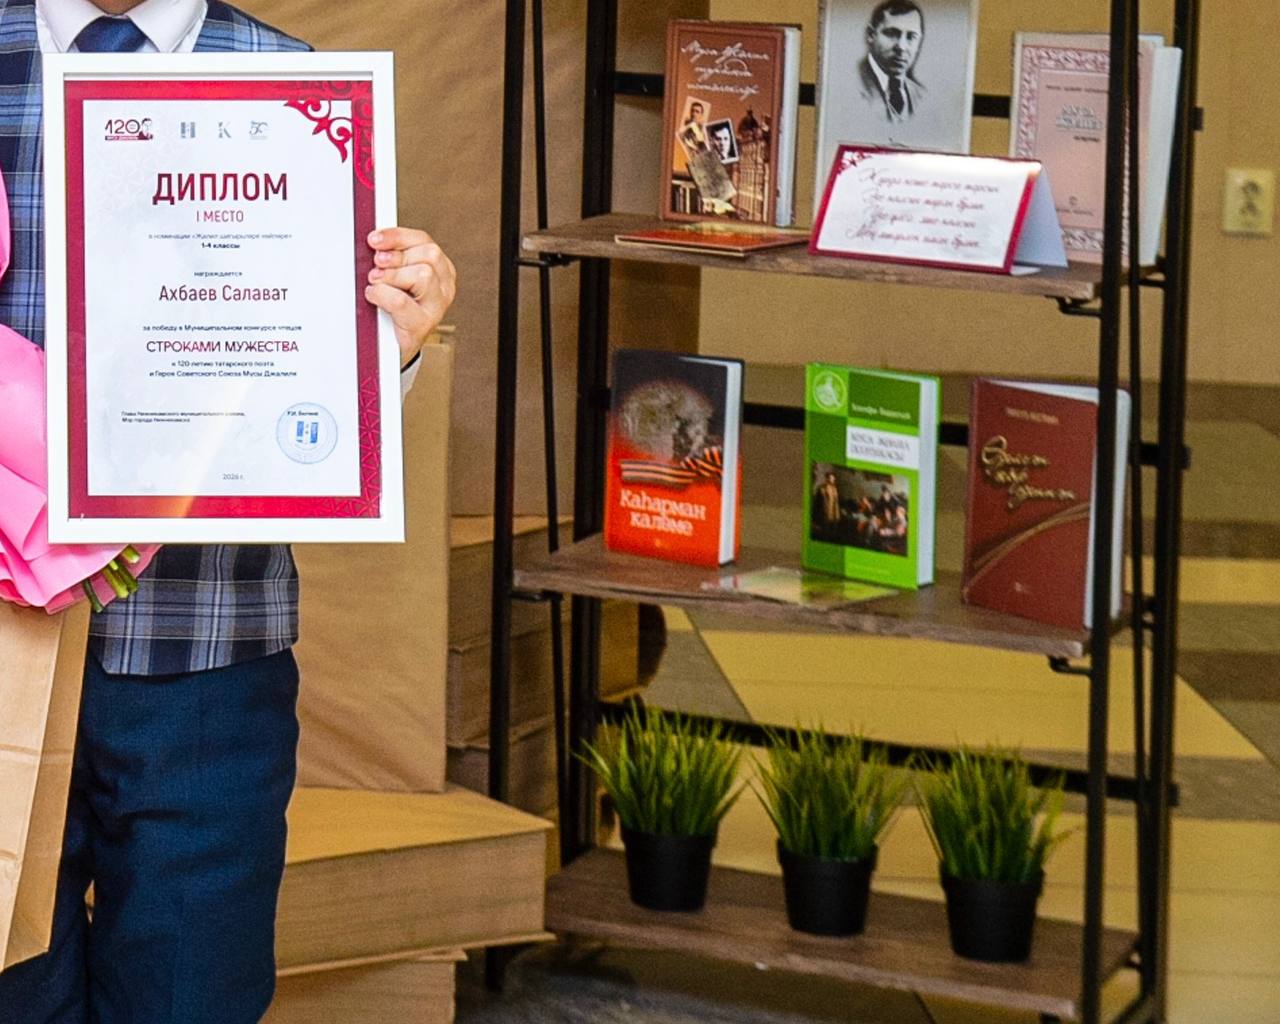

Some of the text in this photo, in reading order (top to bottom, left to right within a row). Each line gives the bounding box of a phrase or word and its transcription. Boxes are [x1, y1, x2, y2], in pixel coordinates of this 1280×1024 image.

[152, 173, 288, 206] ДИПЛОМ
[203, 210, 245, 223] МЕСТО
[159, 284, 289, 302] Ахбаев Салават
[146, 341, 300, 353] СТРОКАМИ МУЖЕСТВА
